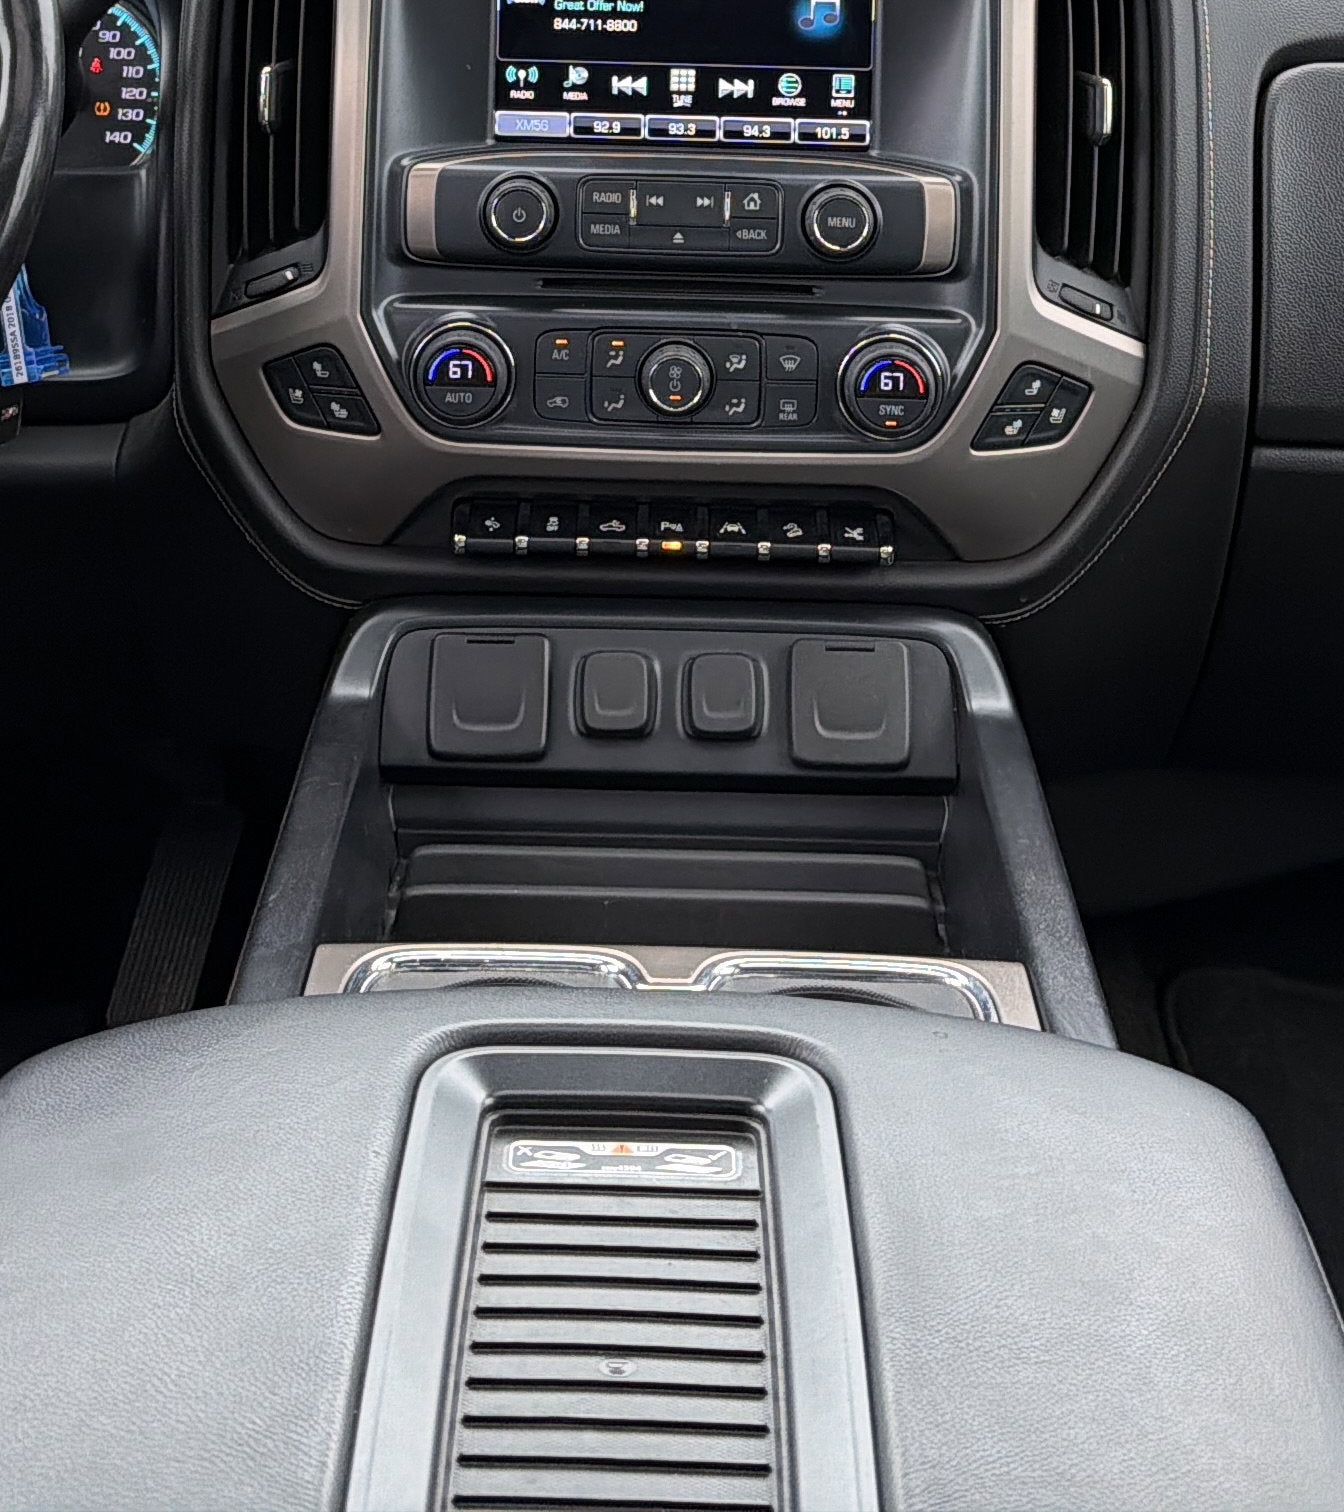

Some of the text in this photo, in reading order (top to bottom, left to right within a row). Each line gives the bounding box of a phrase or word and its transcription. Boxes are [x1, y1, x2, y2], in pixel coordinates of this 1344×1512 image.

[554, 0, 644, 12] Great Offer Now!
[553, 18, 638, 32] 844-711-8800
[98, 30, 121, 43] 90
[109, 47, 135, 60] 100
[122, 66, 144, 78] 110
[121, 87, 147, 100] 120
[510, 90, 535, 99] RADIO
[563, 91, 589, 101] MEDIA
[771, 97, 806, 107] BROWSE
[830, 99, 855, 108] MENU
[117, 108, 144, 121] 130
[515, 119, 850, 140] XM56 92.9 93.3 94.3 101.5
[105, 131, 132, 144] 140
[592, 192, 622, 204] RADIO
[827, 217, 856, 228] MENU
[590, 224, 621, 235] MEDIA
[742, 229, 767, 240] BACK
[551, 349, 570, 362] A/C
[448, 360, 474, 380] 67
[879, 371, 905, 391] 67
[445, 391, 473, 404] AUTO
[778, 411, 798, 421] REAR
[878, 404, 905, 417] SYNC
